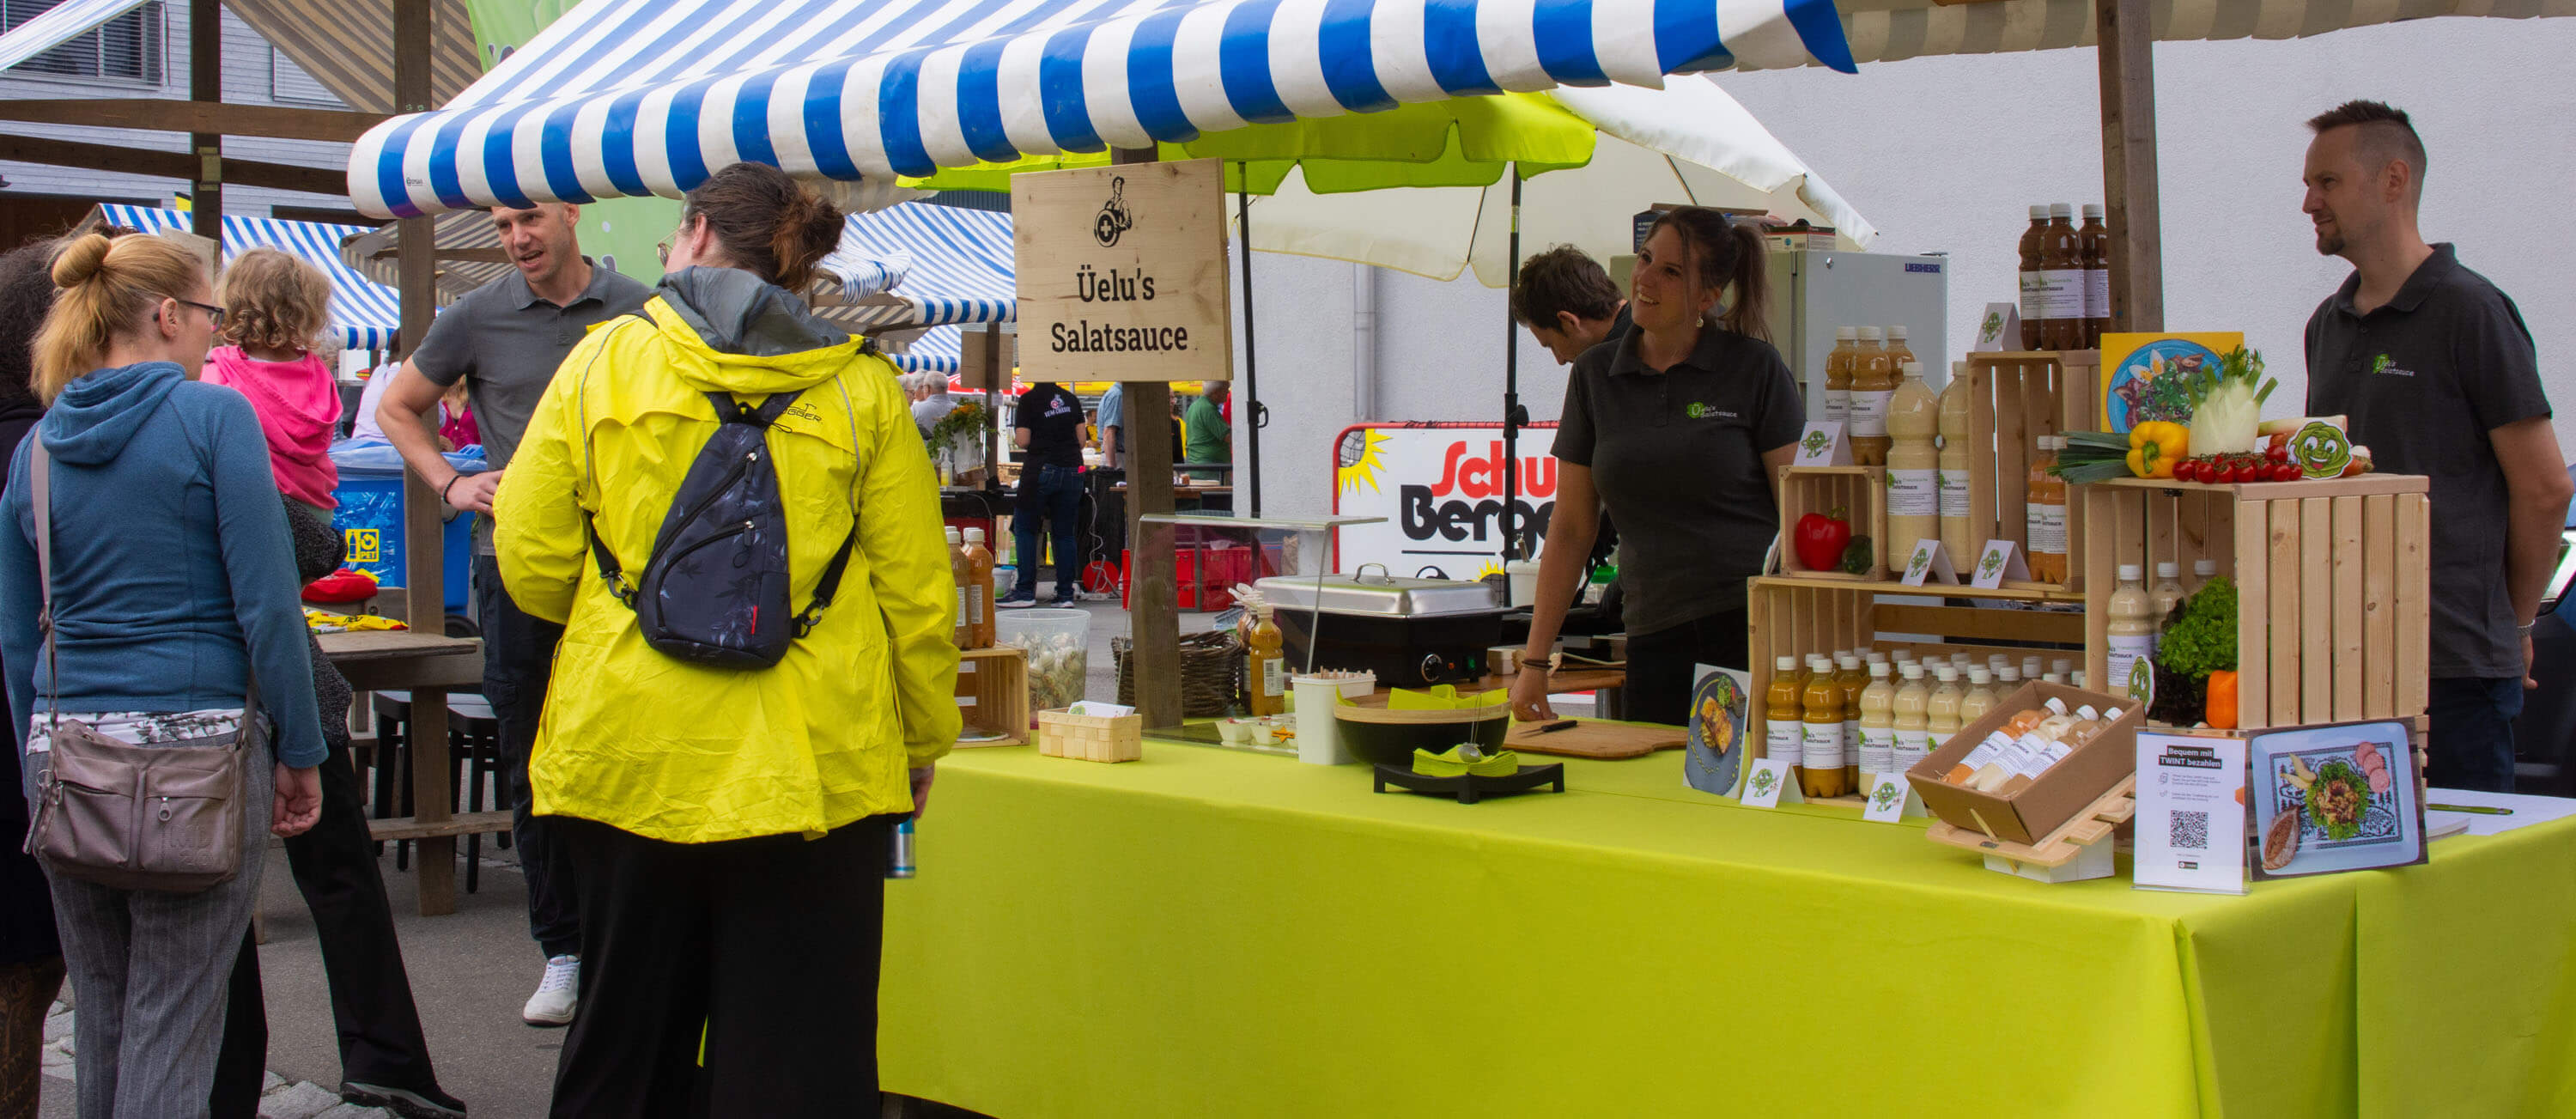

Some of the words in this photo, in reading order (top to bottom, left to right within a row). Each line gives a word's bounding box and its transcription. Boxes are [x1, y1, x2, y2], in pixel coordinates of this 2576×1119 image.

[1905, 263, 1941, 273] LIEBHERR
[1077, 265, 1155, 302] Üelu's
[1051, 319, 1188, 352] Salatsauce
[2168, 746, 2198, 757] Bequem
[2200, 749, 2213, 757] mit
[2160, 756, 2185, 765] TWINT
[2186, 757, 2221, 768] bezahlen
